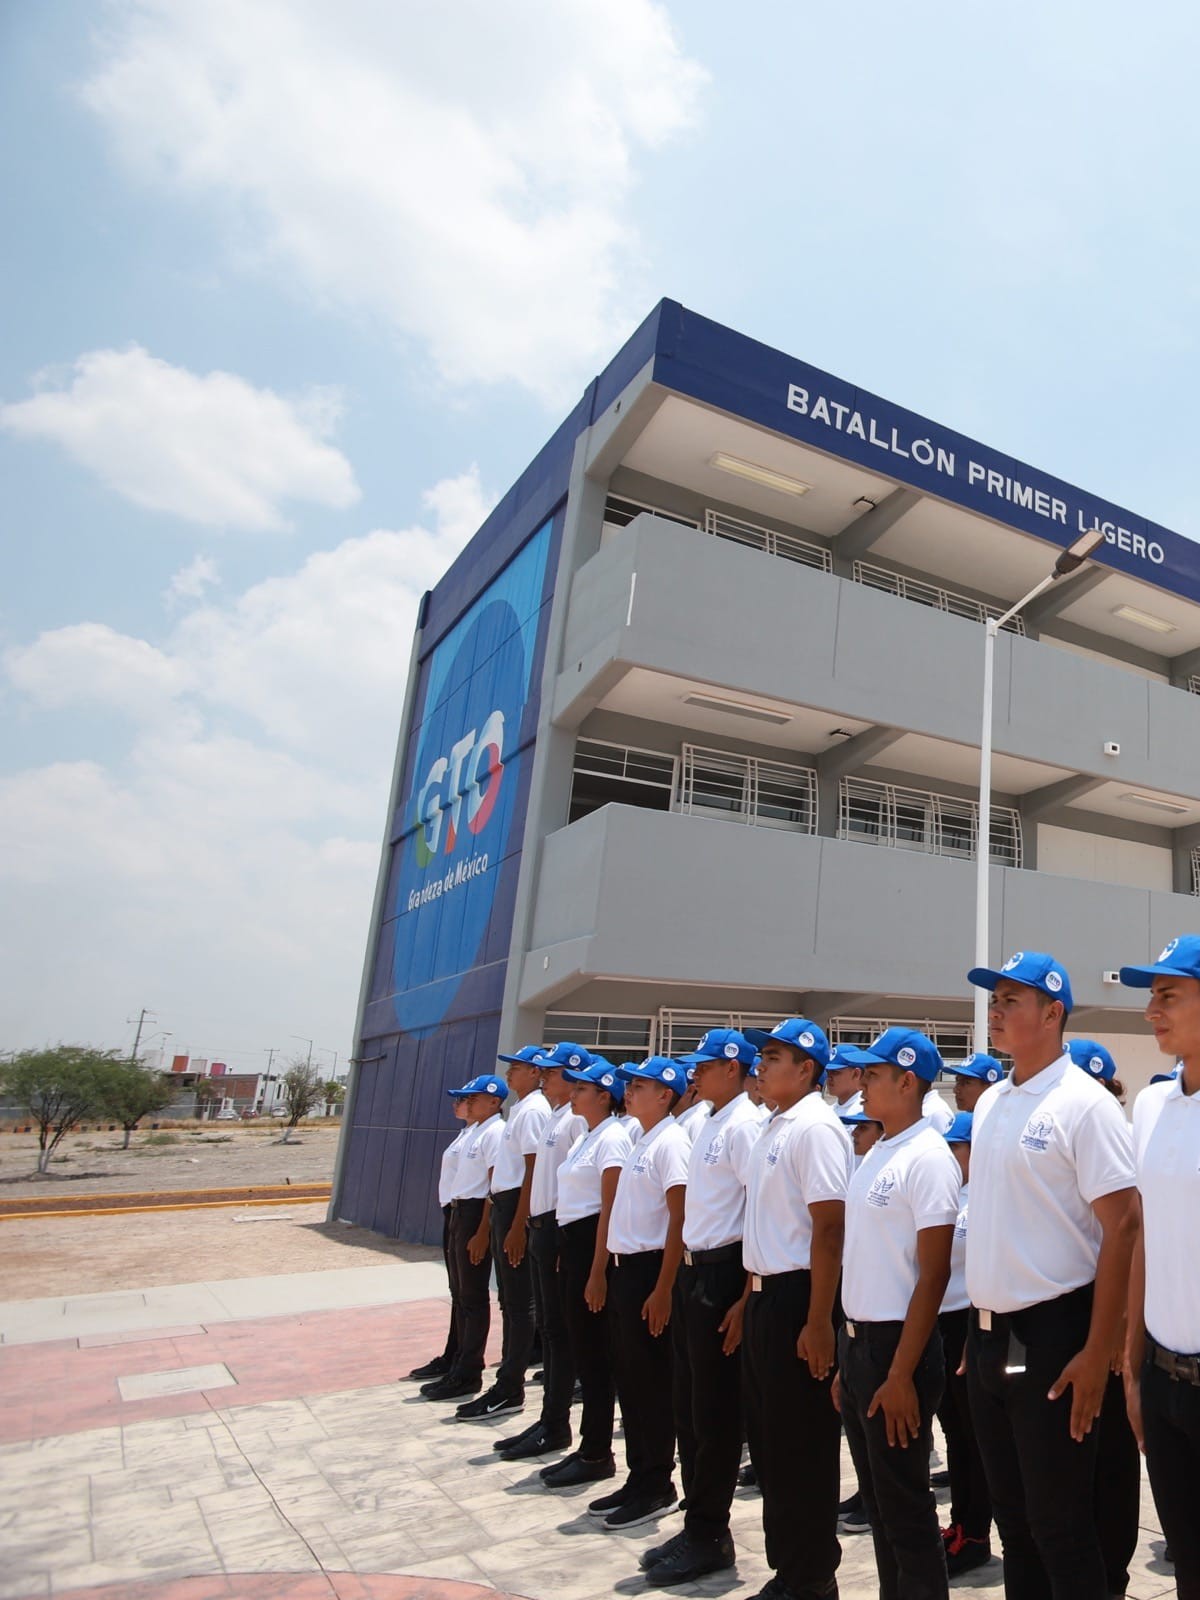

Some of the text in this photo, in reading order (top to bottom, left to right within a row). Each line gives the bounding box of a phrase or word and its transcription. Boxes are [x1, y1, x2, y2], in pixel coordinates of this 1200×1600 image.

[787, 383, 1165, 564] BATALLÓN PRIMER LIGERO
[417, 710, 505, 868] GTO
[443, 867, 454, 892] de
[454, 851, 488, 886] México
